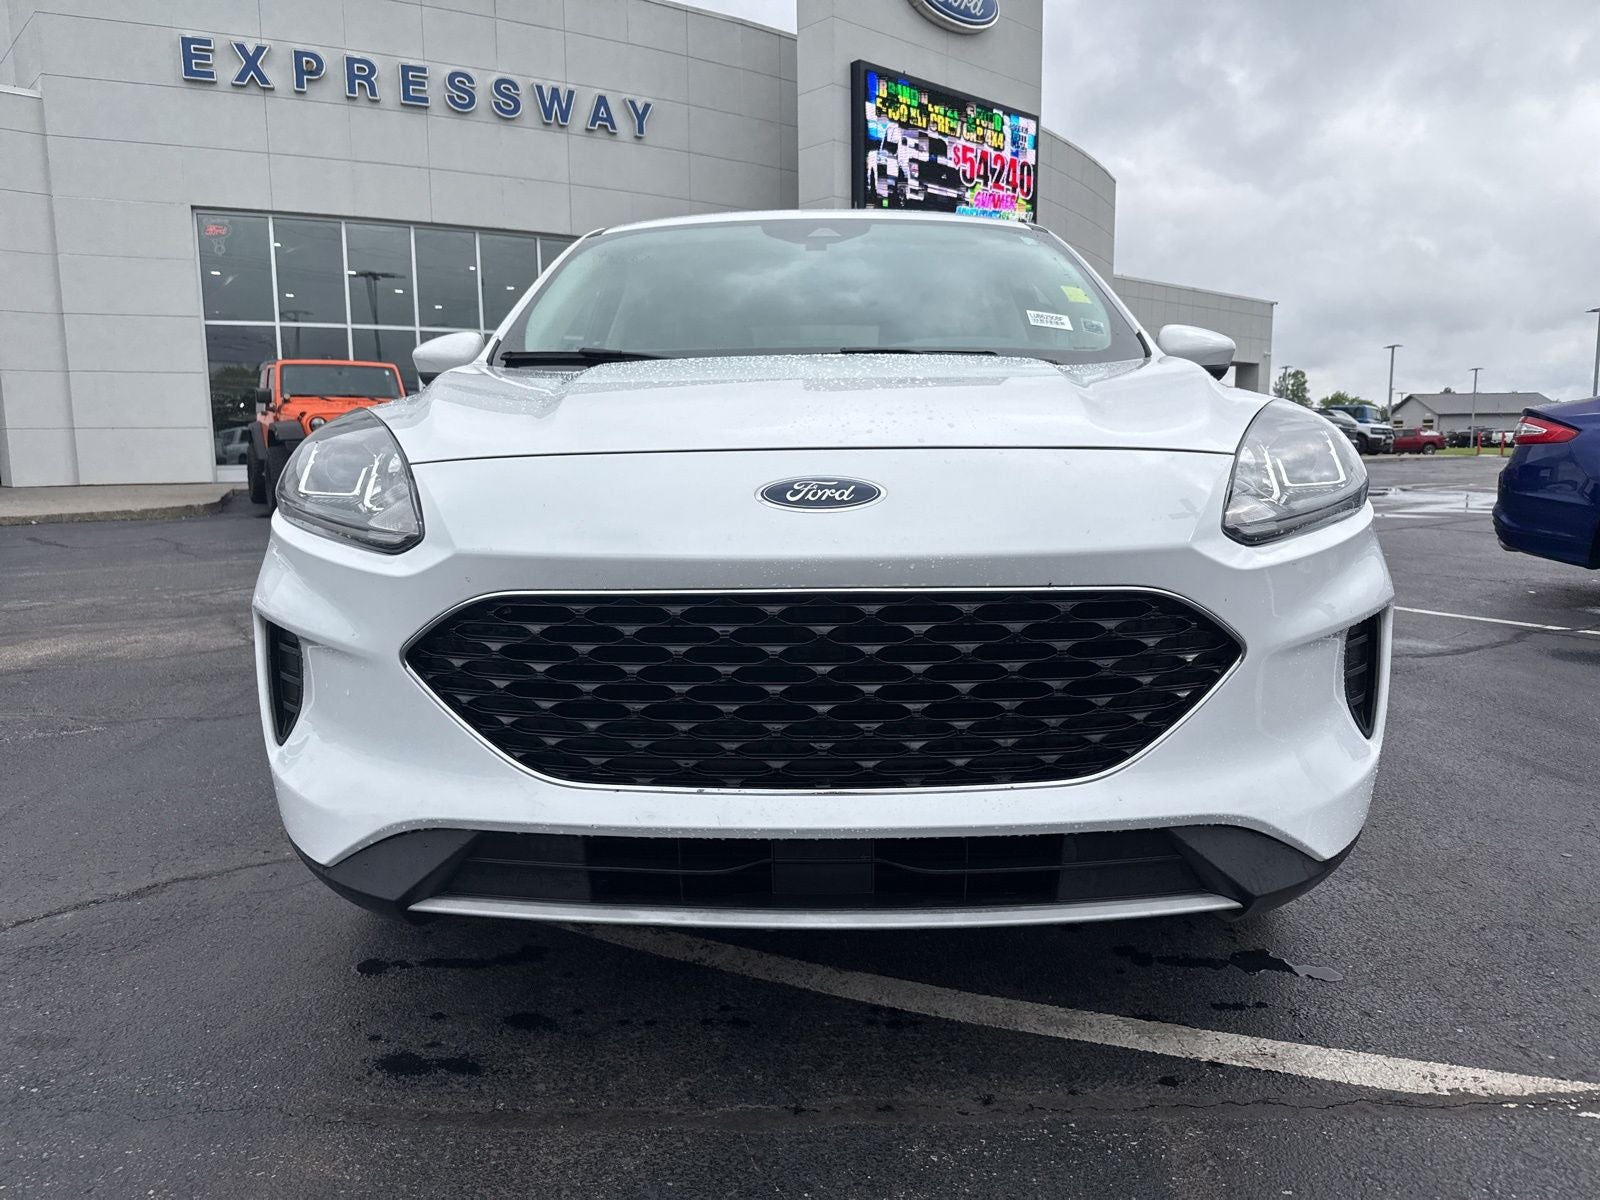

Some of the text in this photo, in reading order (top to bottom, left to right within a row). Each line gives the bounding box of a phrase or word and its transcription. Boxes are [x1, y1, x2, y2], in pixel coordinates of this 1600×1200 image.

[179, 35, 653, 137] EXPRESSWAY
[952, 143, 1033, 198] $54240
[786, 480, 856, 501] Ford
